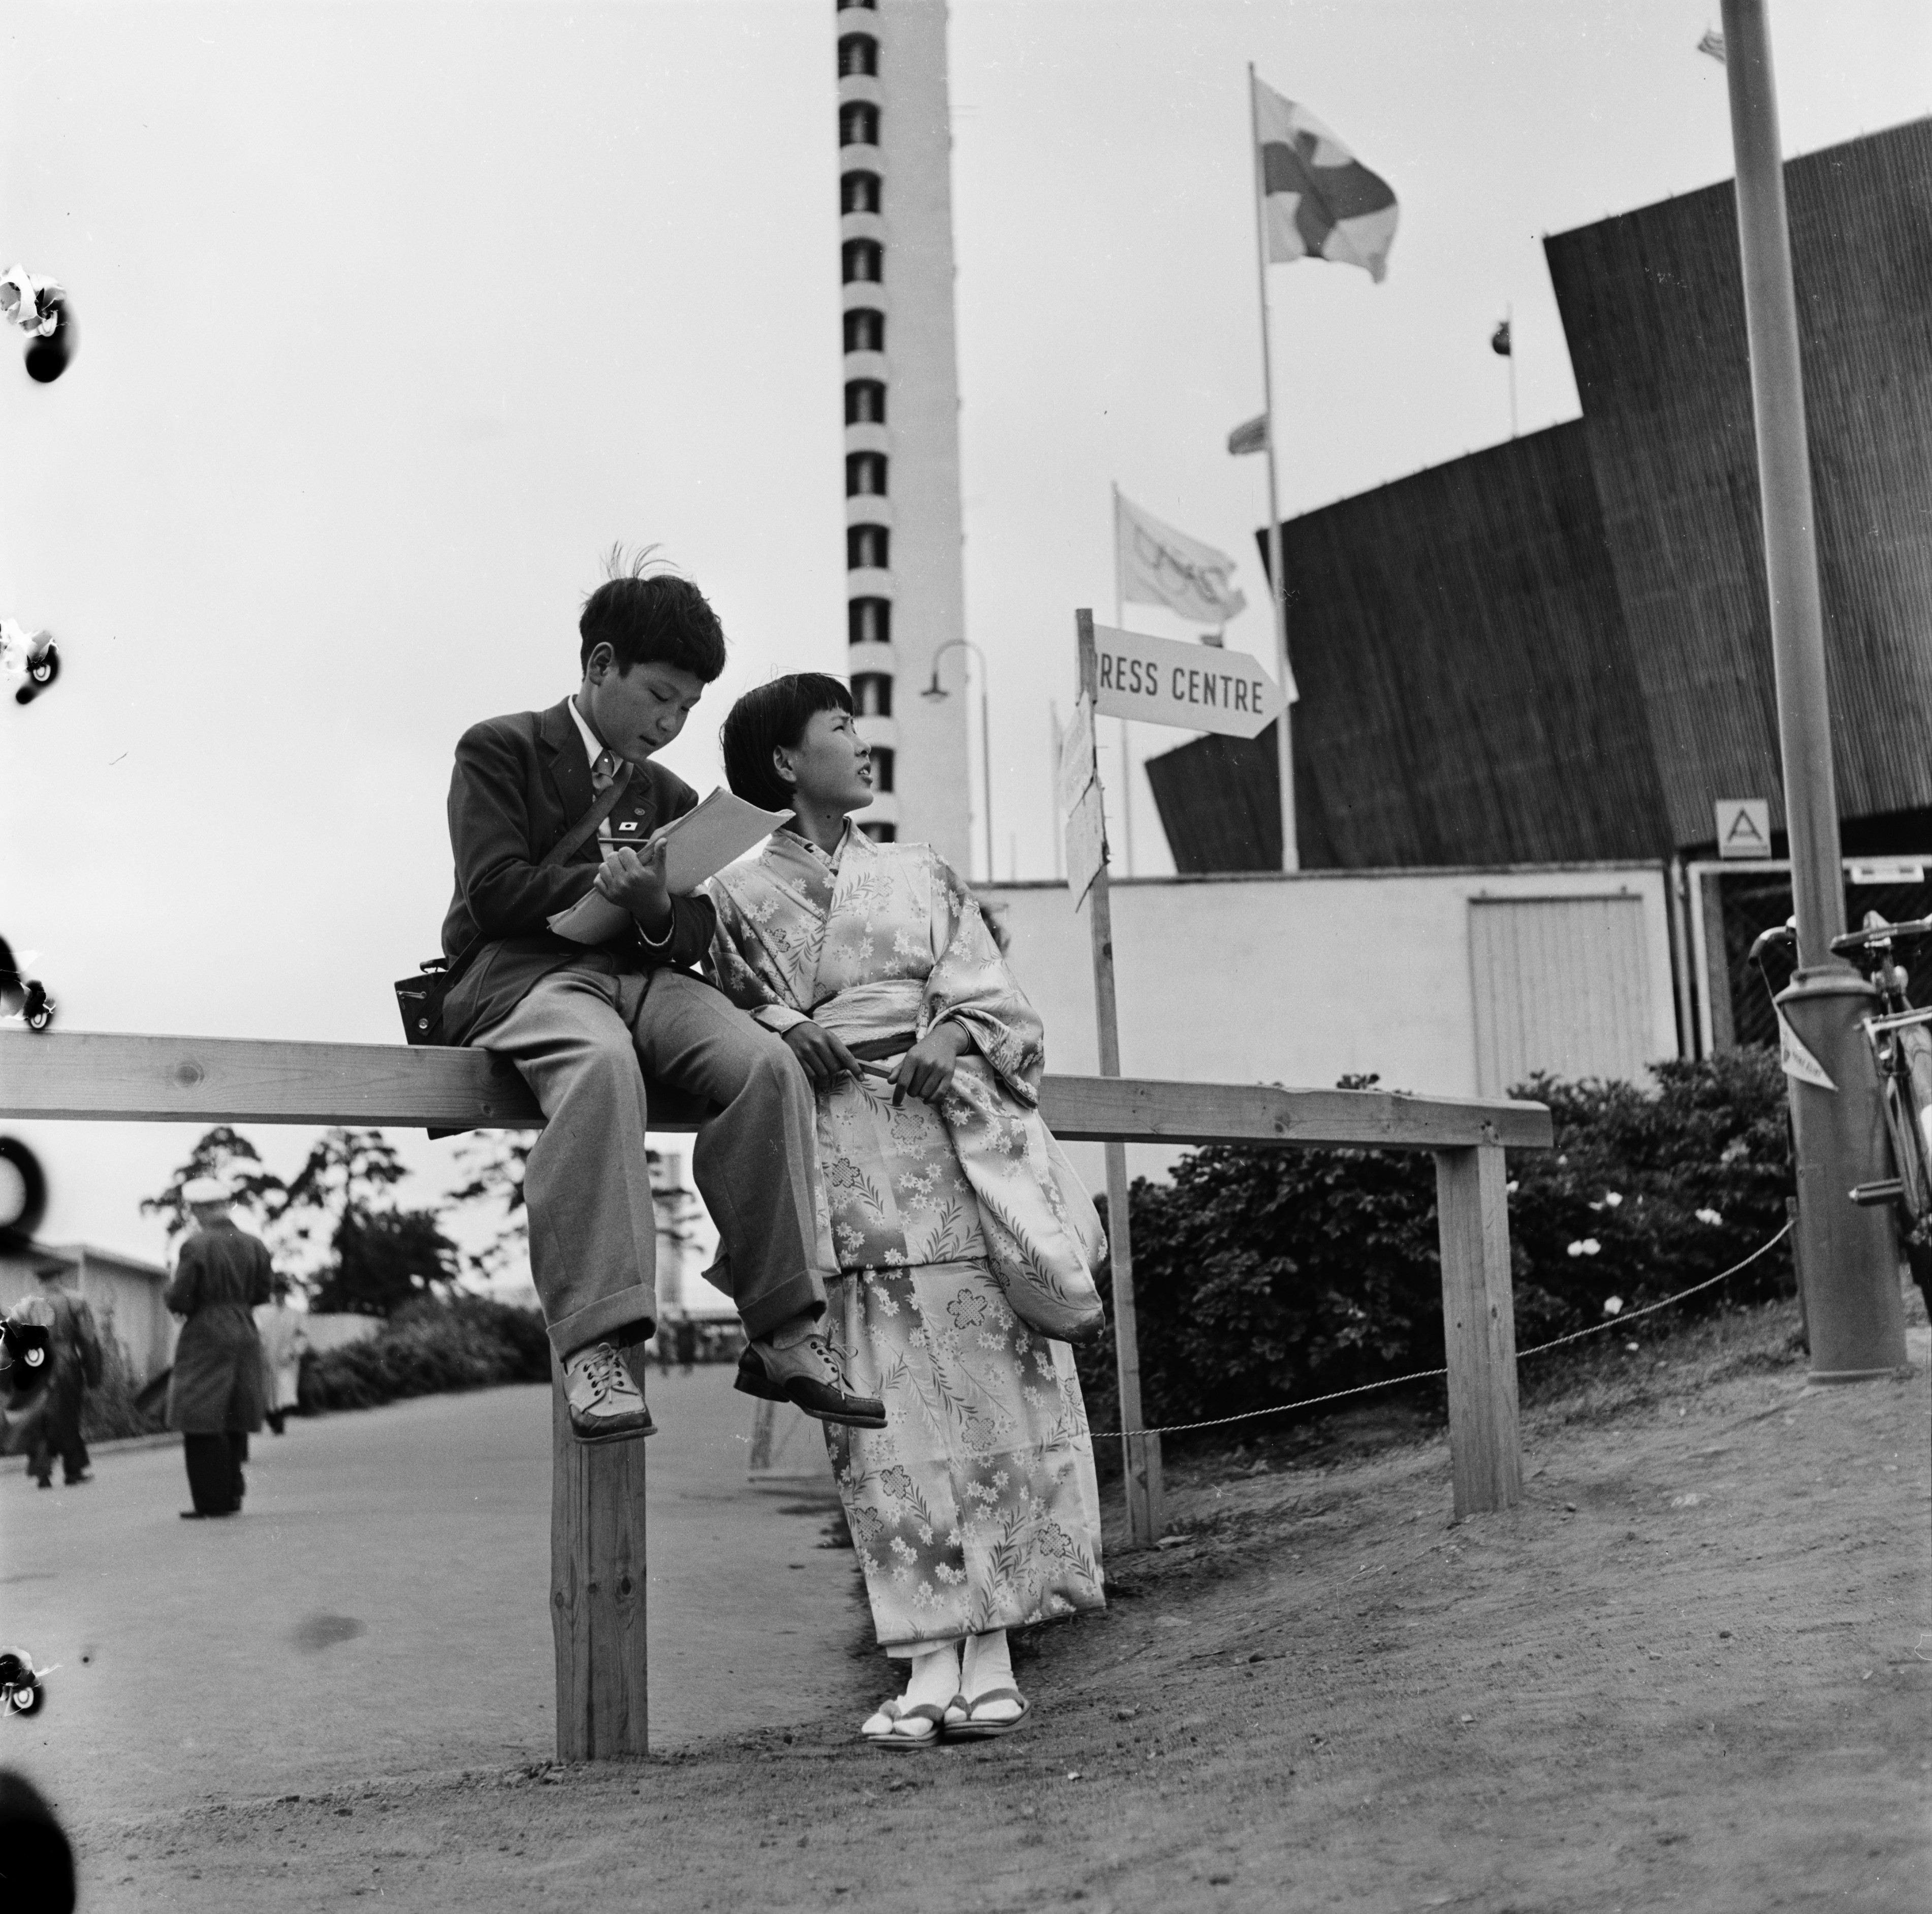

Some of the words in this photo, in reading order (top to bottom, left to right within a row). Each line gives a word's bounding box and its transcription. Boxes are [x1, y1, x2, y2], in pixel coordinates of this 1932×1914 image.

[1096, 653, 1158, 696] RESS
[1172, 667, 1263, 715] CENTRE
[1727, 807, 1763, 842] A
